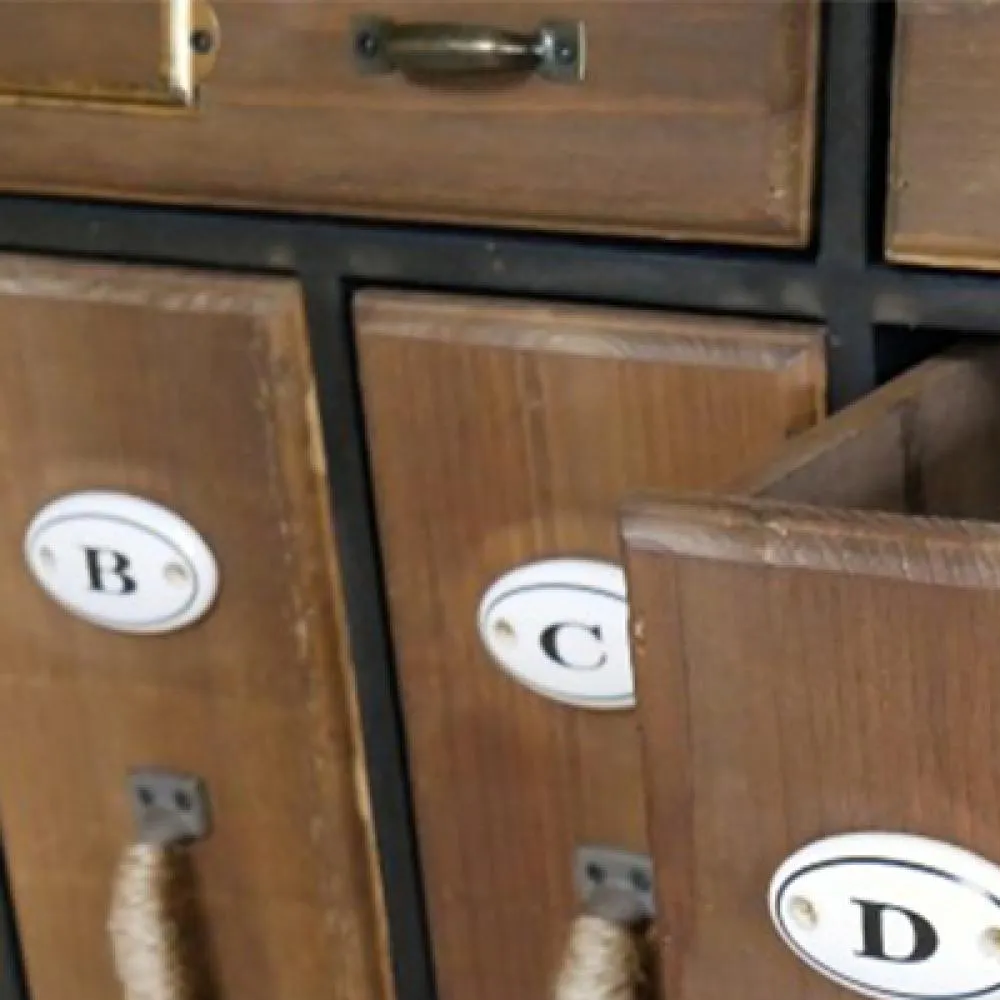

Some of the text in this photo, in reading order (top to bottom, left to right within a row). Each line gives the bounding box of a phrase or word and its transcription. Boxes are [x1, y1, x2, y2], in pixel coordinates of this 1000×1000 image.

[84, 546, 137, 595] B
[538, 621, 608, 671] C
[851, 897, 939, 963] D
